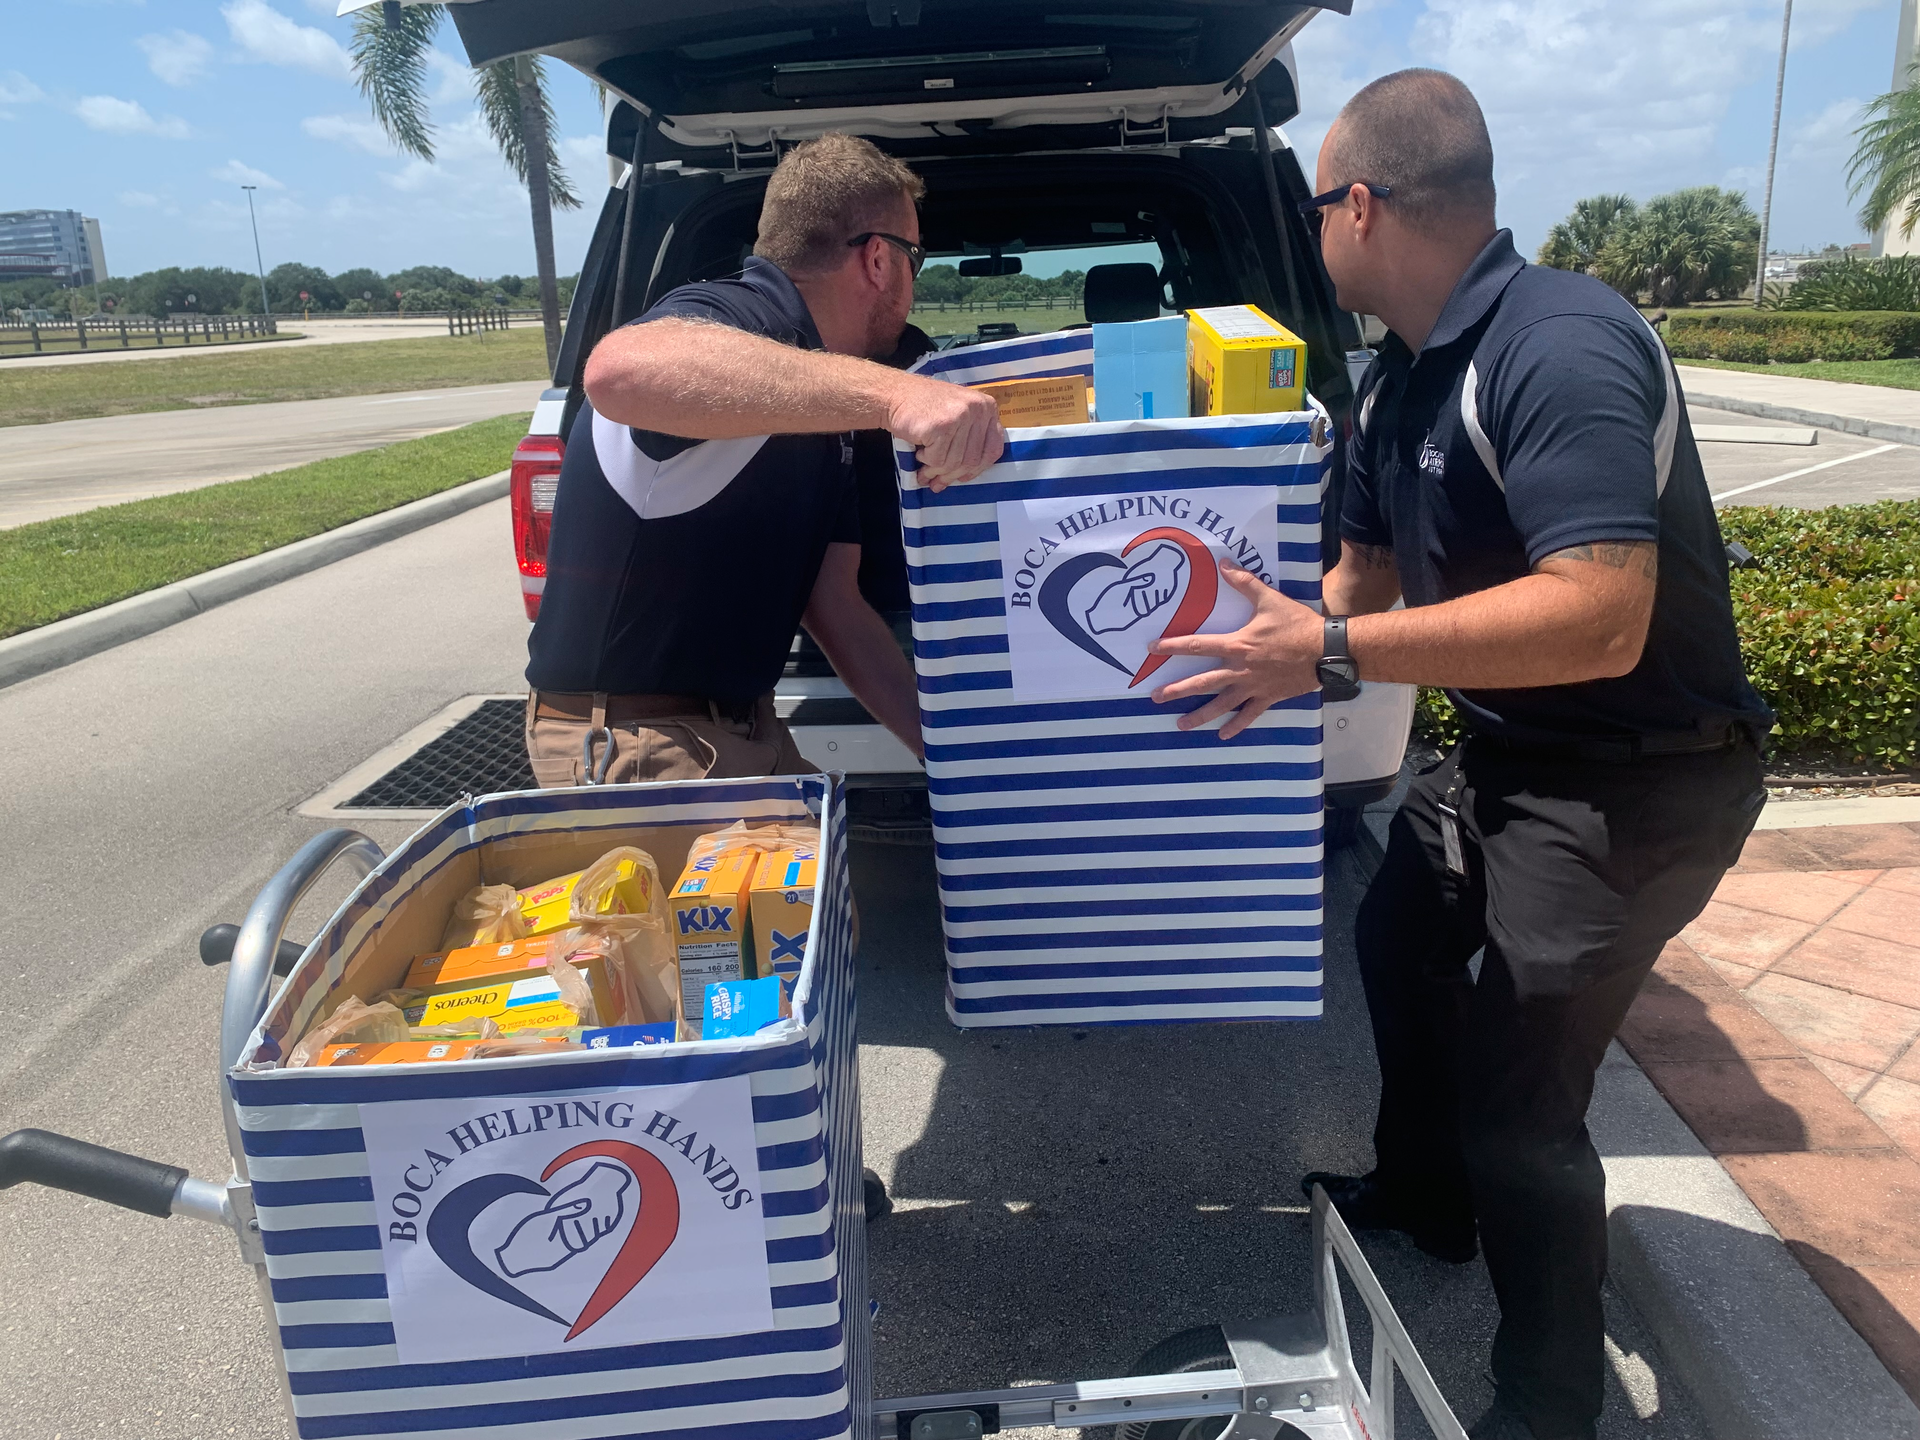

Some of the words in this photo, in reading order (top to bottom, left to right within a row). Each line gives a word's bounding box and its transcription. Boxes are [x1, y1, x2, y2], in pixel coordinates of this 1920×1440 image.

[1011, 536, 1060, 609] BOCA
[1055, 495, 1192, 540] HELPING
[677, 906, 733, 935] KIX
[725, 963, 740, 971] 200
[434, 992, 498, 1012] Cheerios
[710, 995, 722, 1020] RICE
[718, 987, 731, 1020] CRISPY
[528, 1013, 560, 1026] 100%
[389, 1149, 455, 1244] BOCA
[445, 1101, 634, 1155] HELPING
[641, 1109, 754, 1210] HANDS
